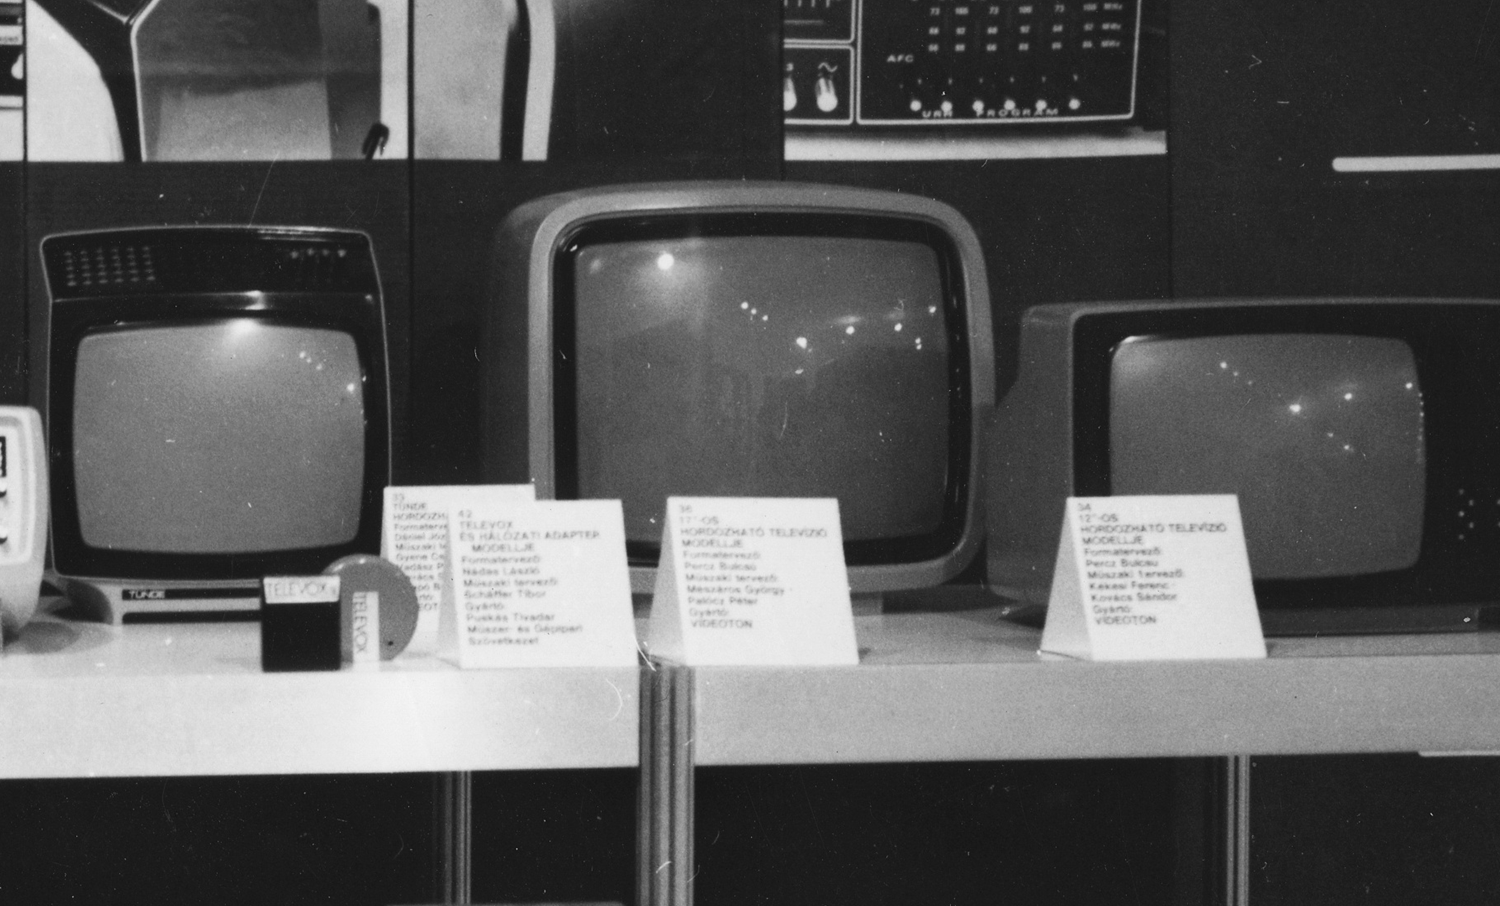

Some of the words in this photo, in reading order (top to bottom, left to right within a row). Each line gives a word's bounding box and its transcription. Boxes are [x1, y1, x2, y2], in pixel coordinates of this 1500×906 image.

[887, 54, 914, 63] AFC
[458, 510, 472, 518] 42
[460, 521, 512, 529] TELEVOX
[1081, 524, 1164, 533] HORDOZHATÓ
[1169, 523, 1227, 532] TELEVÍZIÓ
[681, 526, 764, 537] HORDOZHATÓ
[769, 527, 827, 538] TELEVÍZIÓ
[682, 539, 742, 548] MODELLJE
[1082, 536, 1144, 545] MODELLJE
[472, 543, 535, 552] MODELLJE
[267, 581, 327, 597] TELEVOX
[354, 593, 367, 653] TELEVOX
